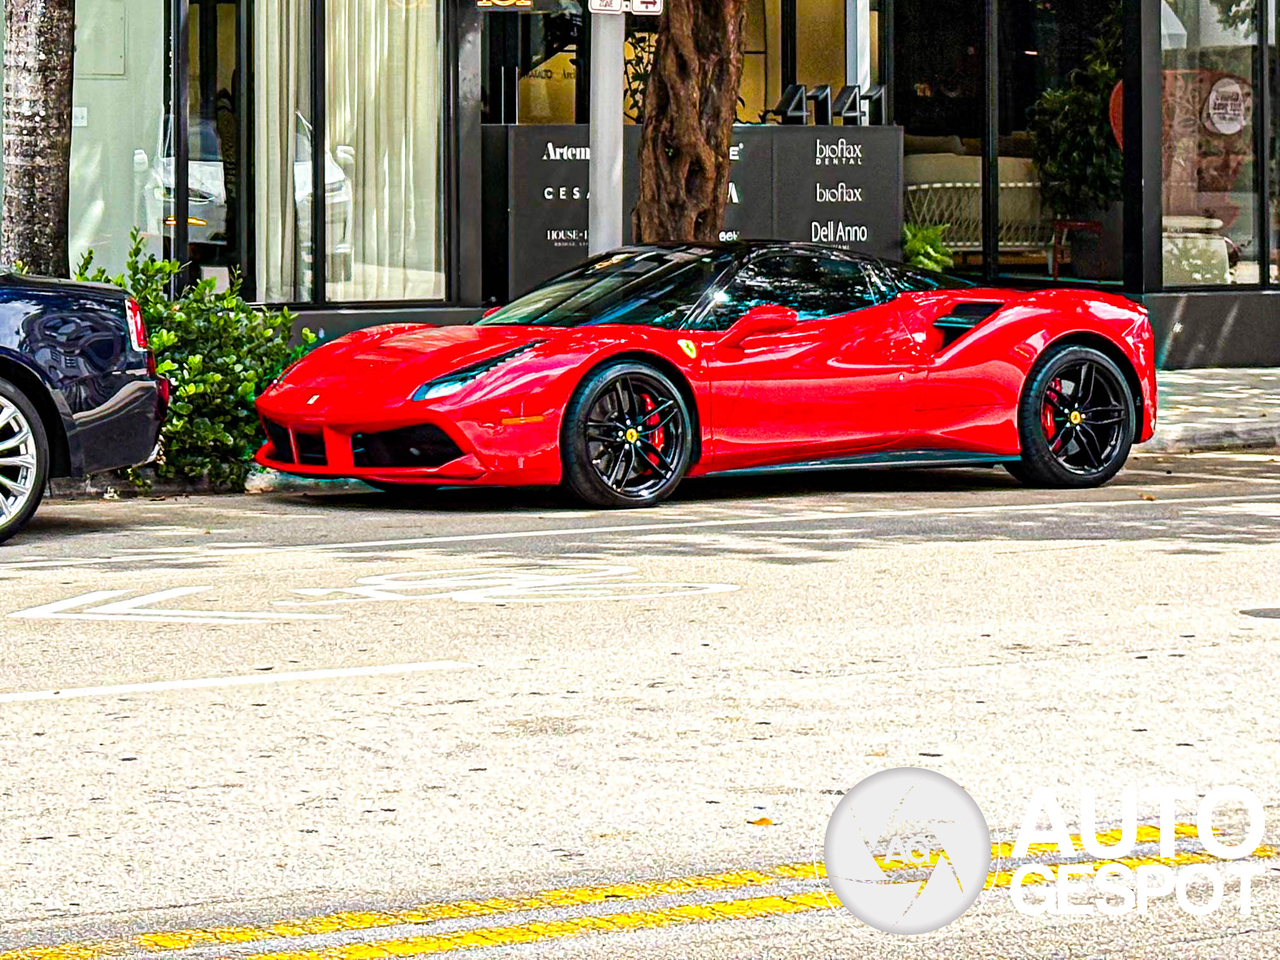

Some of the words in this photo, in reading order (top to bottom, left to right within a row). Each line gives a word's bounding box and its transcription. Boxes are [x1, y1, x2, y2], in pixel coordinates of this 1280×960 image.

[782, 84, 886, 126] 4141
[815, 157, 862, 166] DENTAL
[811, 221, 834, 242] Dell
[835, 221, 868, 242] Anno
